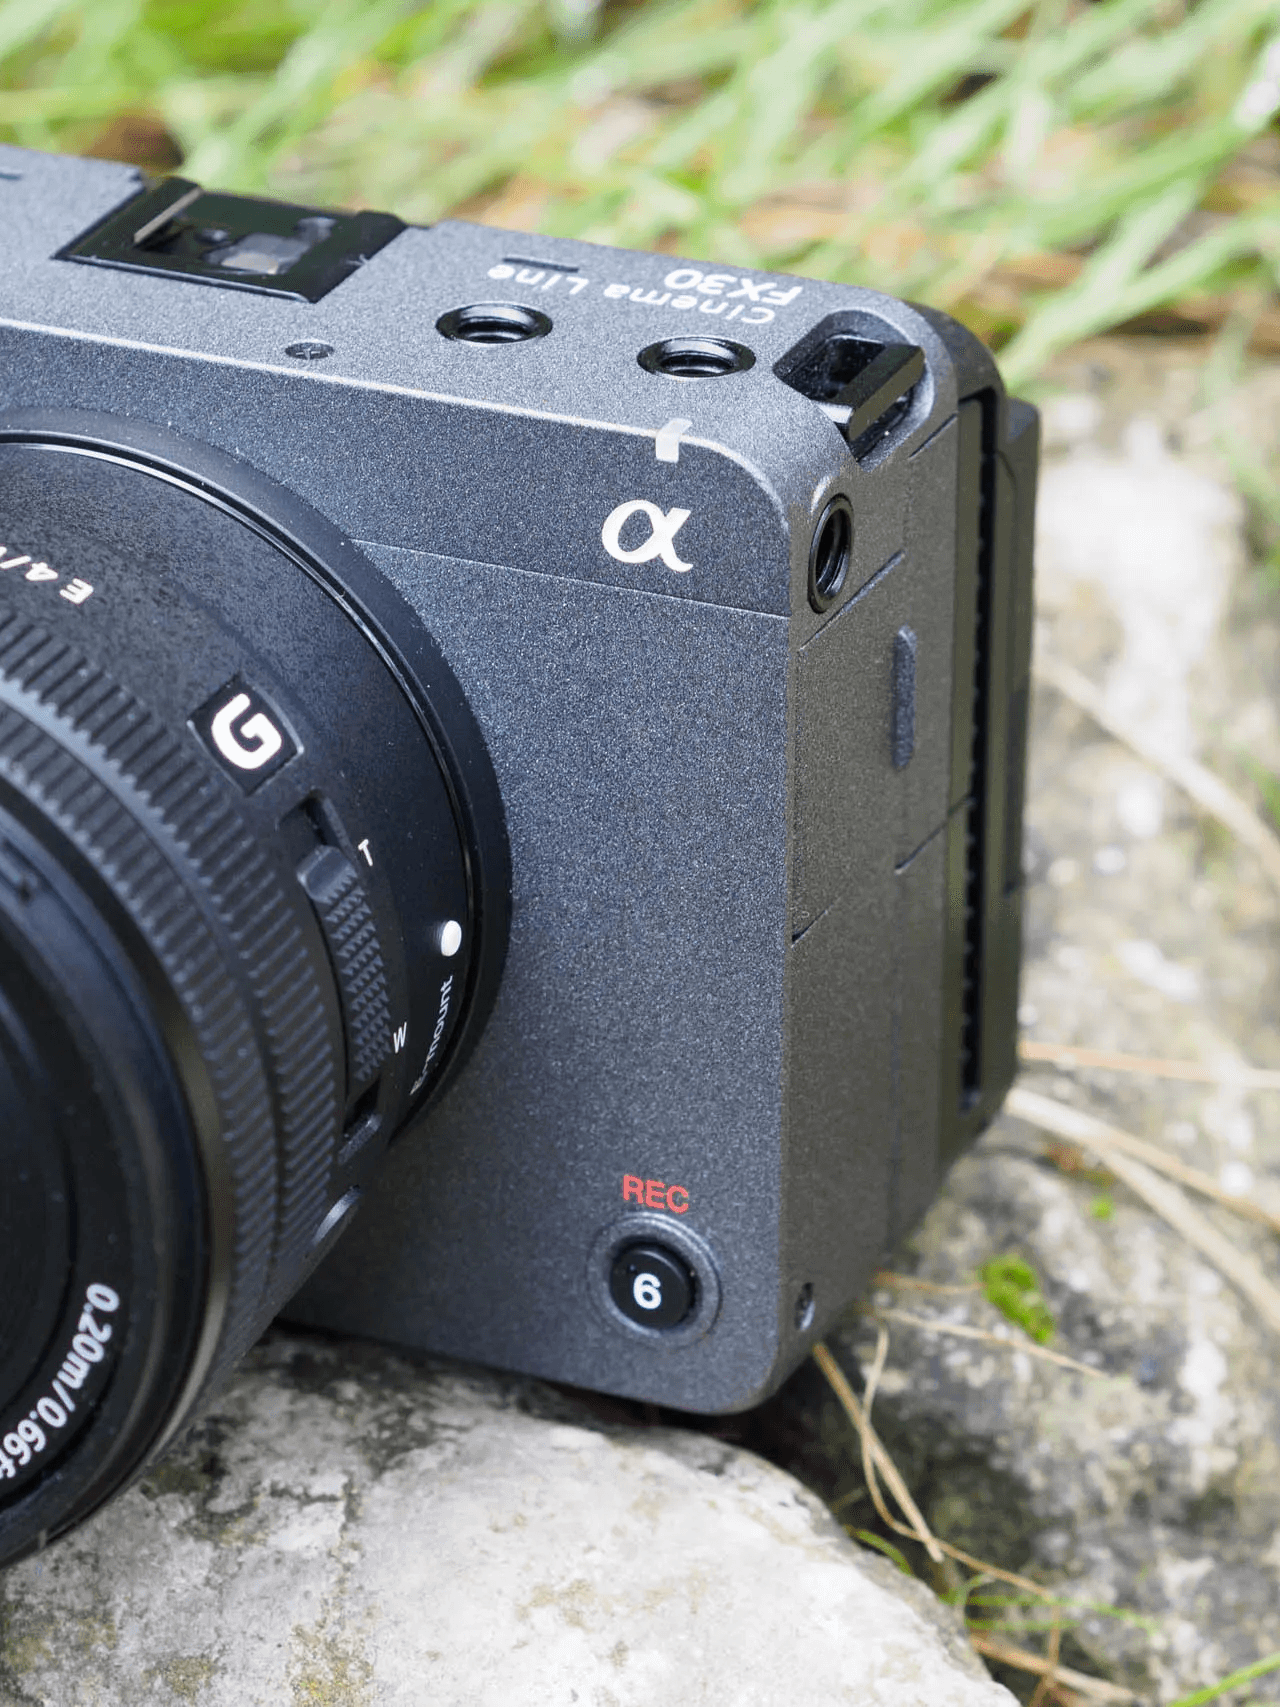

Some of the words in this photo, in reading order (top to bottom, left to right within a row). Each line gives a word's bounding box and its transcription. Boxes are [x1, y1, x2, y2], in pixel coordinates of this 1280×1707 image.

[486, 263, 591, 296] Line
[663, 268, 805, 308] FX30
[602, 282, 777, 326] Cinema
[59, 578, 95, 605] E
[211, 693, 283, 770] G
[357, 838, 374, 867] T
[393, 1021, 408, 1055] W
[622, 1174, 690, 1214] REC
[633, 1272, 662, 1310] 6
